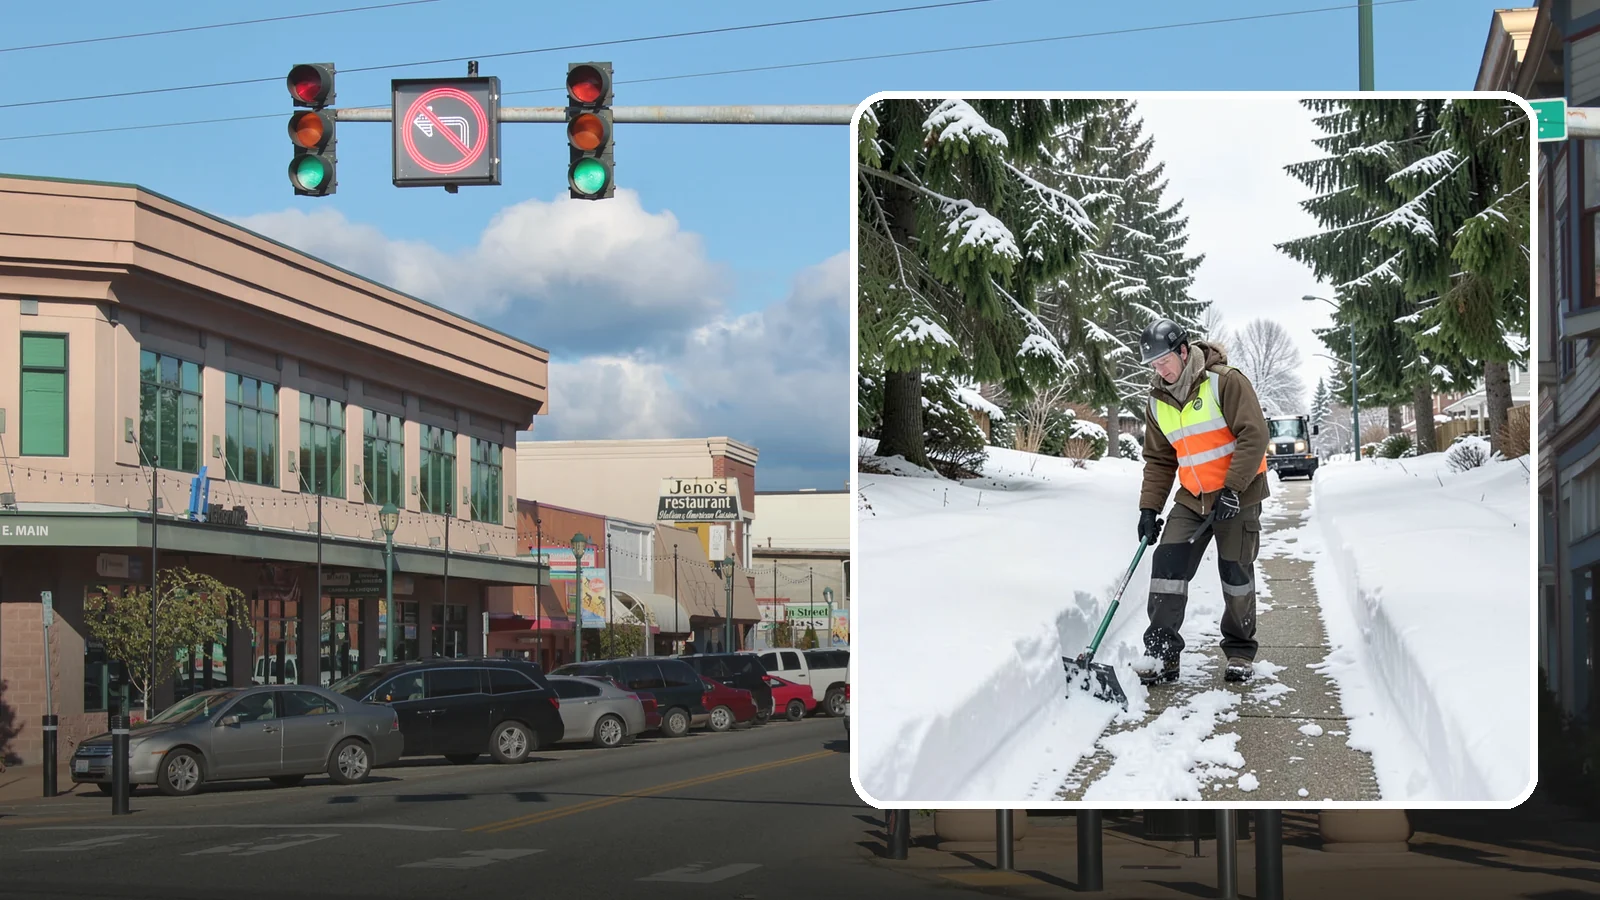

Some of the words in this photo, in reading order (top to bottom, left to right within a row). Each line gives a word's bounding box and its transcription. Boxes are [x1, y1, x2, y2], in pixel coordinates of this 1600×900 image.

[669, 479, 728, 495] Jeno's
[664, 496, 731, 509] restaurant
[658, 509, 682, 520] Italian
[686, 509, 714, 520] American
[715, 509, 738, 520] Cuisine
[2, 525, 13, 536] E.
[15, 525, 49, 536] MAIN
[797, 607, 828, 617] Street
[790, 619, 824, 627] lass
